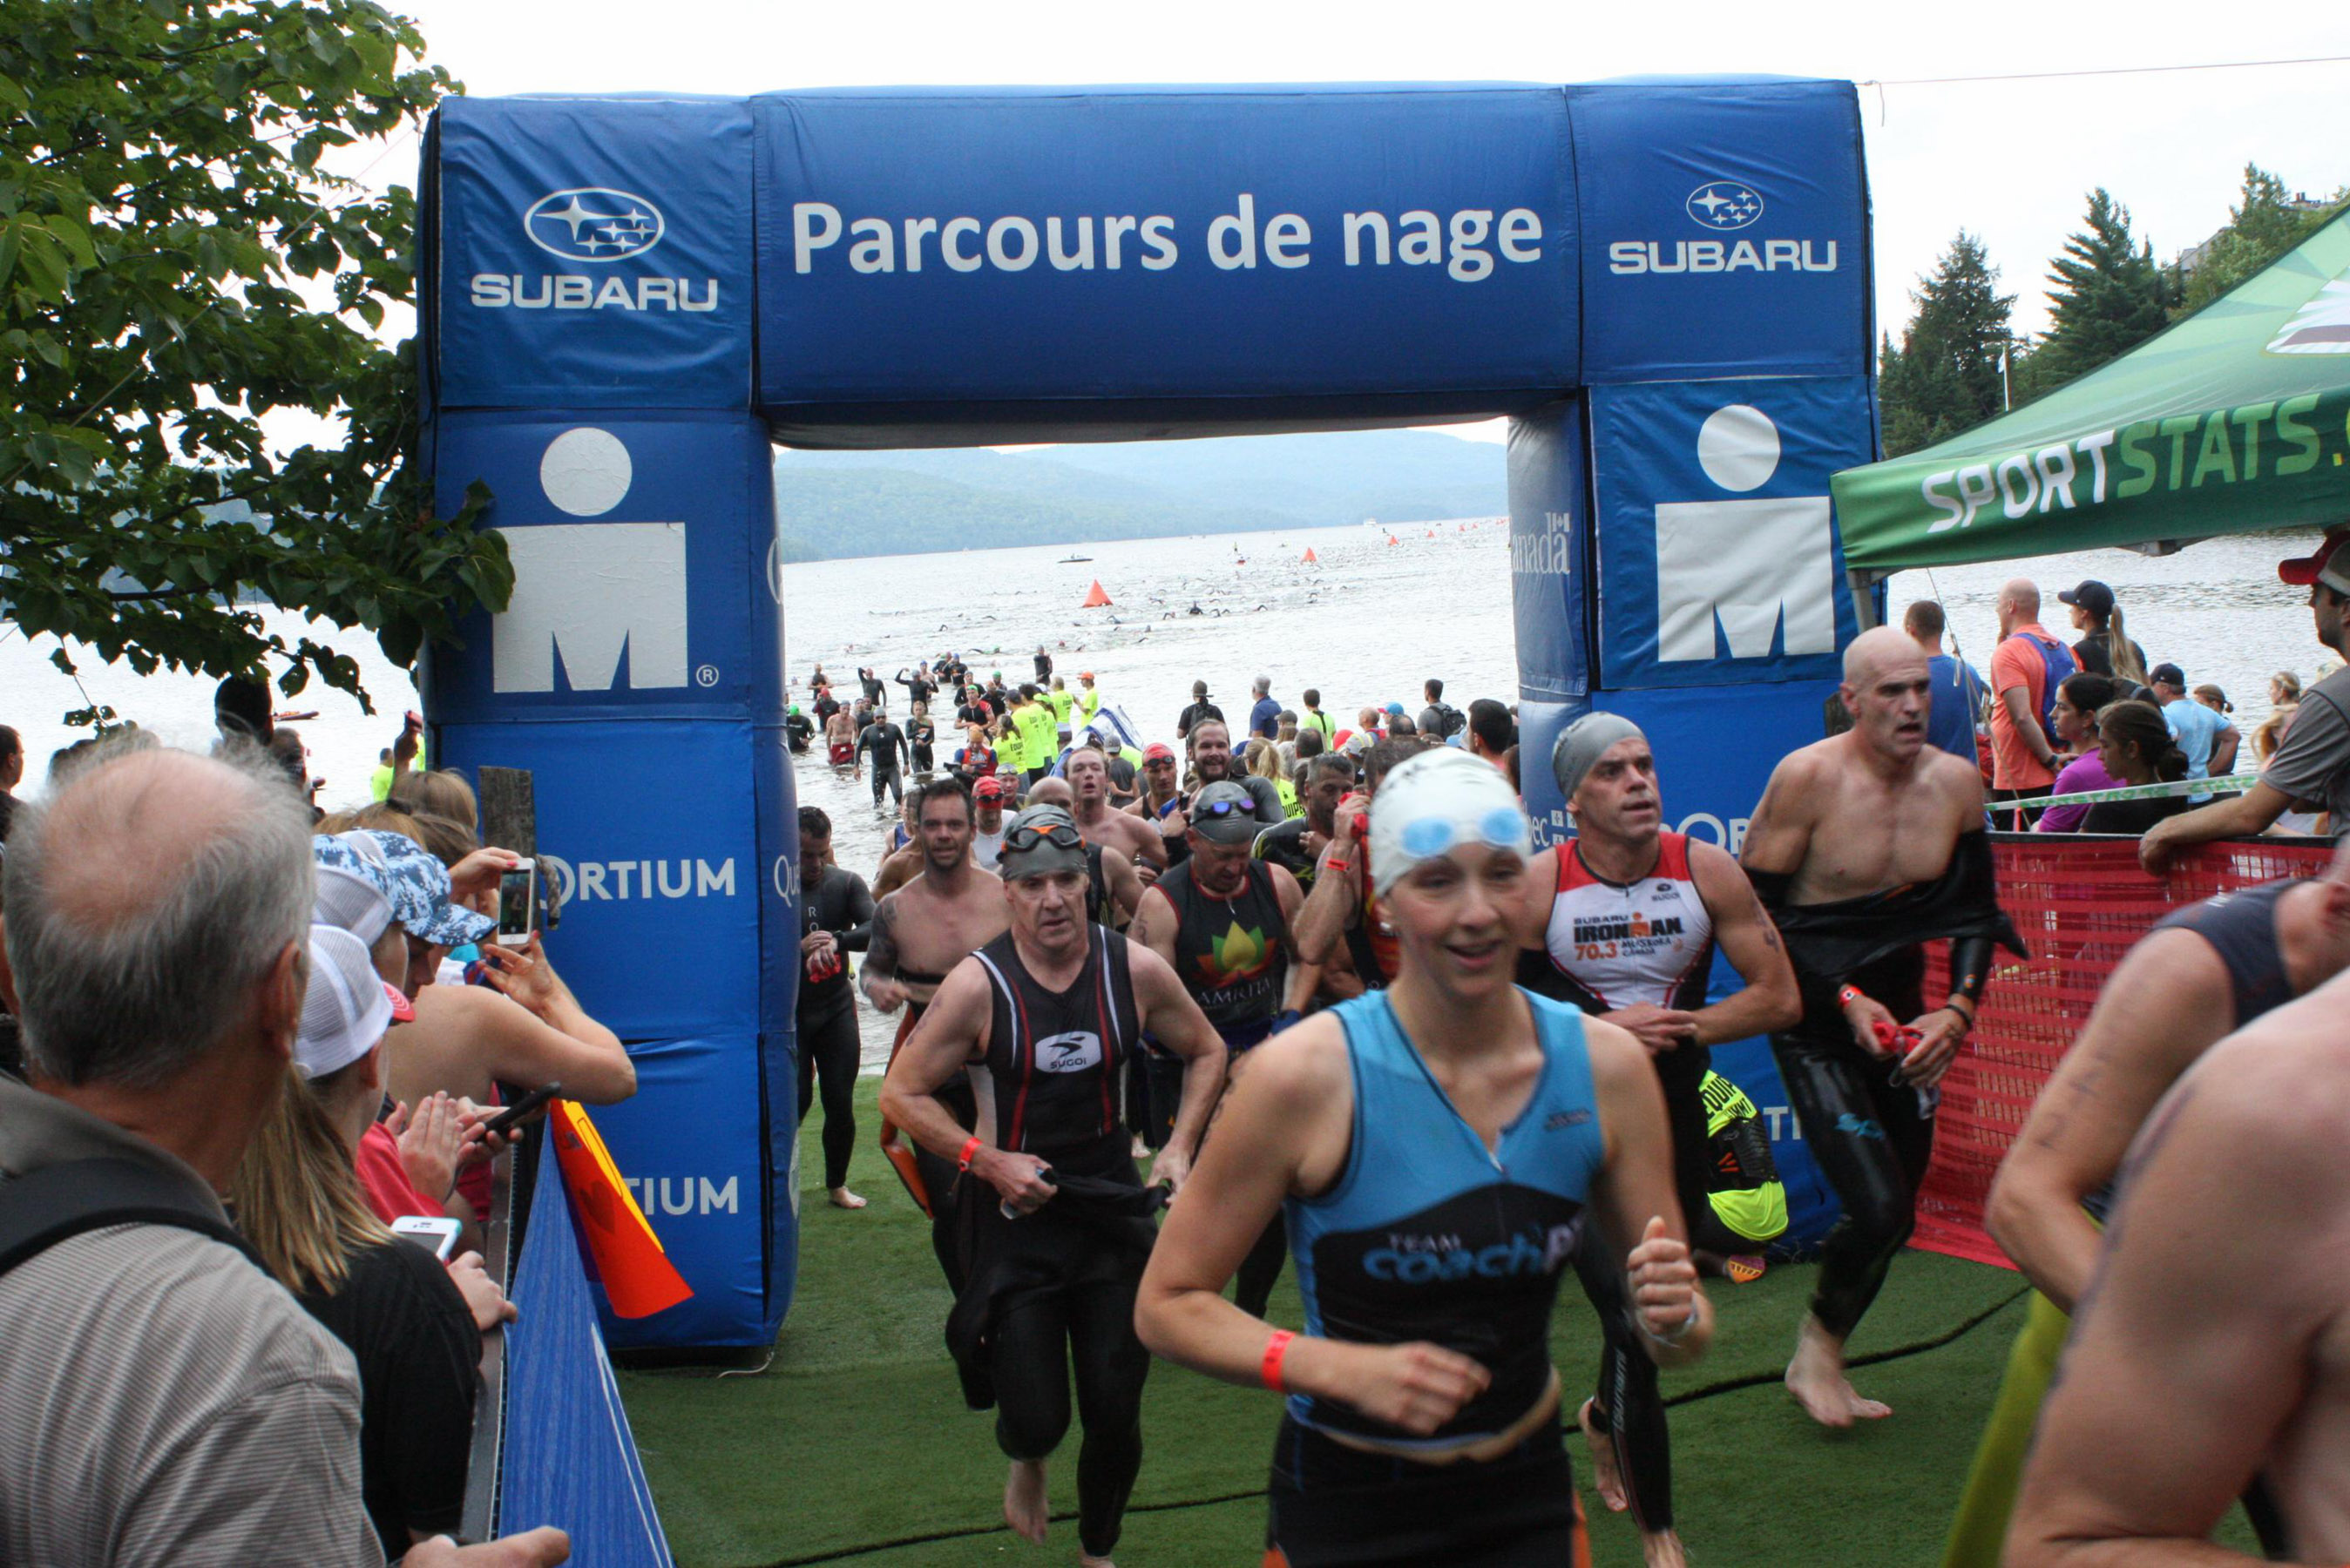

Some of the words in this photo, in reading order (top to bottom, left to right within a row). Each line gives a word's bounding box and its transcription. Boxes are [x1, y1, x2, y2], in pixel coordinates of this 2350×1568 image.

[792, 201, 1178, 274] Parcours
[1208, 193, 1311, 270] de
[1343, 207, 1542, 282] nage
[1608, 240, 1838, 275] SUBARU
[471, 272, 719, 312] SUBARU
[1575, 942, 1618, 961] 70.3
[1050, 1058, 1087, 1070] SUGOI
